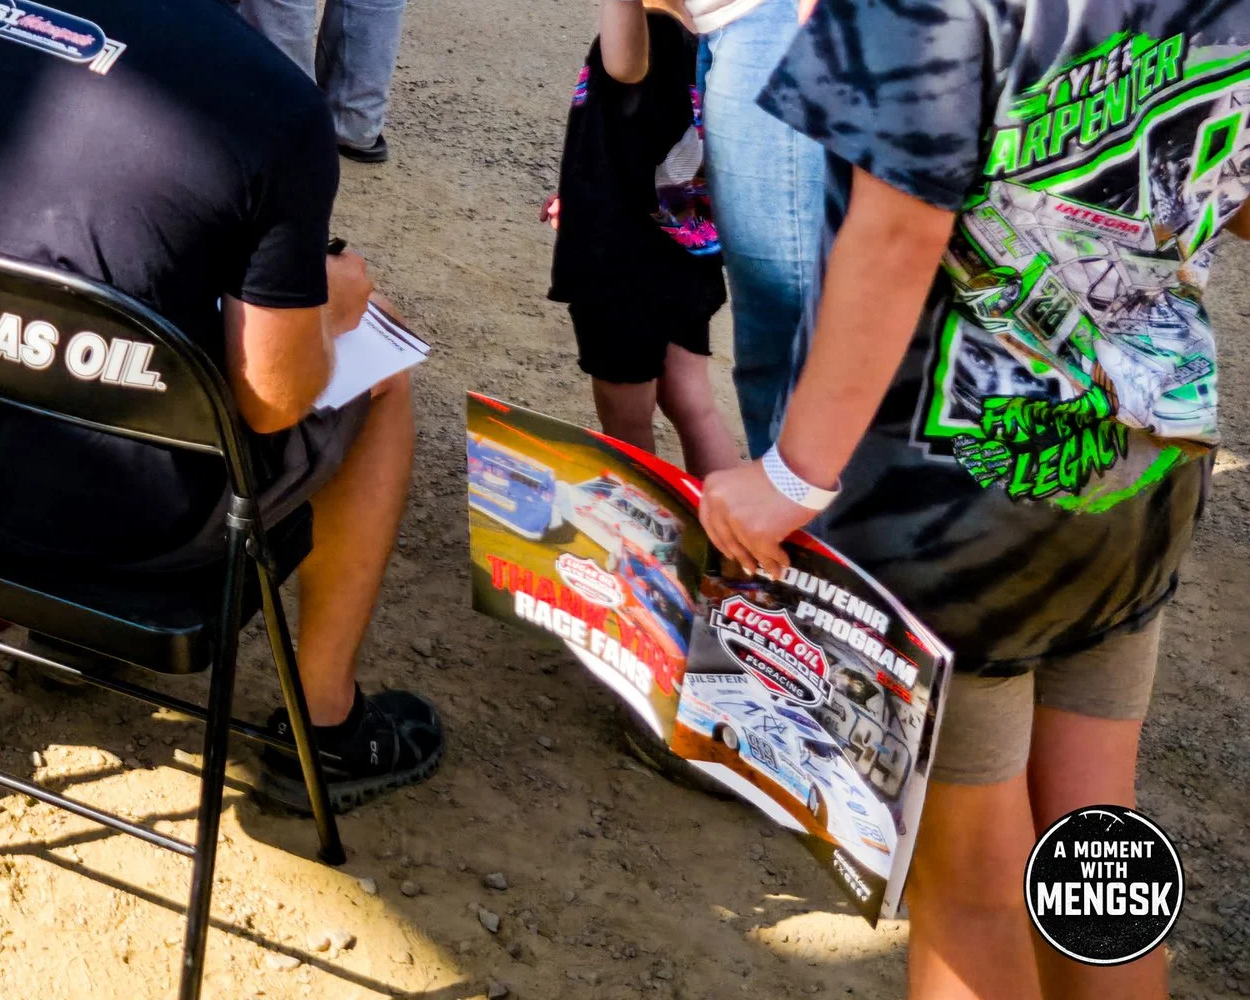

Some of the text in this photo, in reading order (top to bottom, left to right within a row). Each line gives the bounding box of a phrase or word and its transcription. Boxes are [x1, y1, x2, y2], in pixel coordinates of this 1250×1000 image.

[1055, 203, 1141, 234] INTEGRA
[514, 590, 653, 696] RACE FANS
[716, 613, 832, 699] LATE MODEL
[733, 607, 820, 671] LUCAS OIL
[745, 654, 805, 699] FLORACING
[796, 601, 919, 690] PROGRAM
